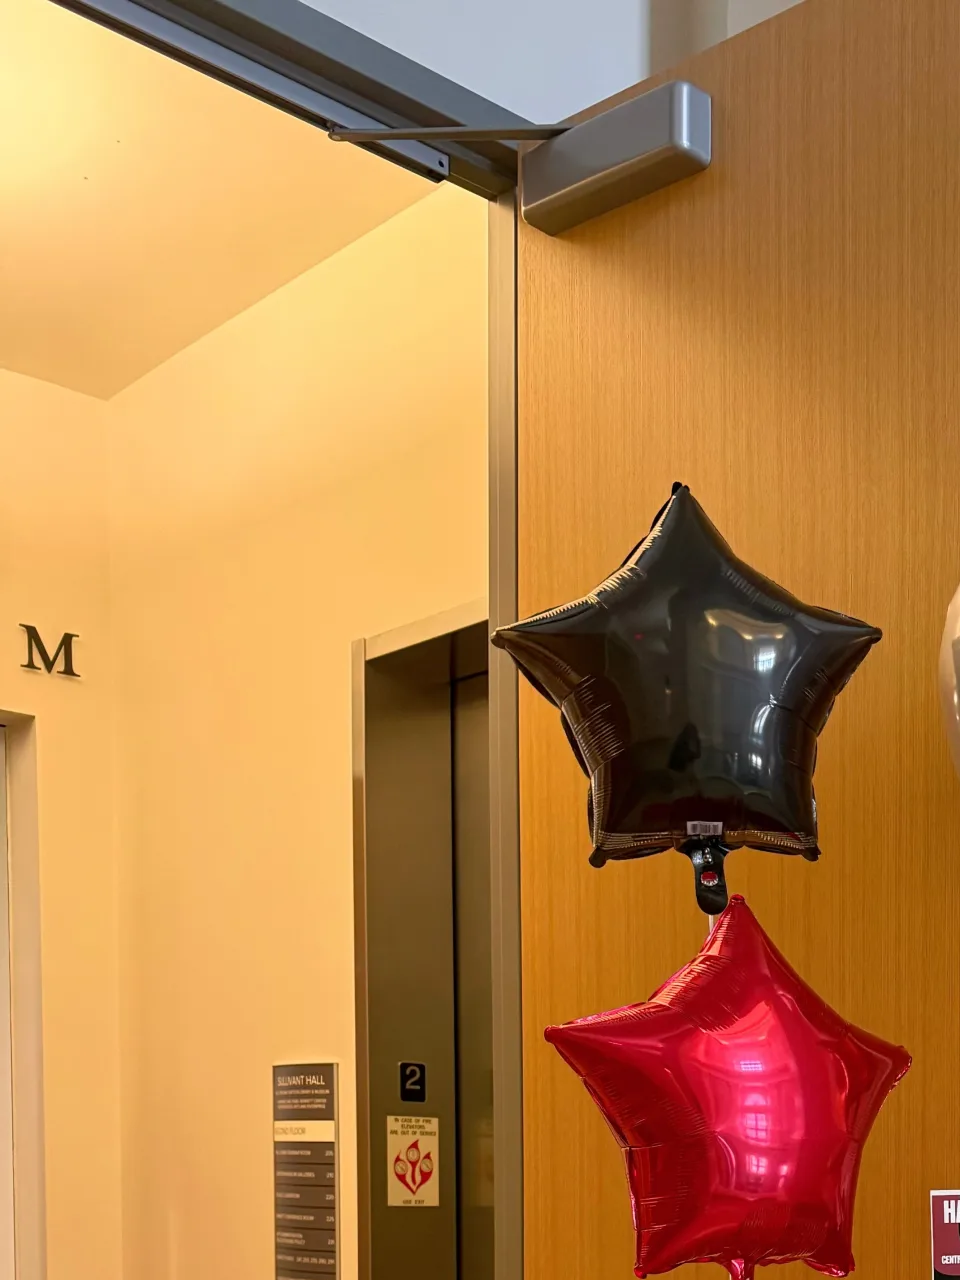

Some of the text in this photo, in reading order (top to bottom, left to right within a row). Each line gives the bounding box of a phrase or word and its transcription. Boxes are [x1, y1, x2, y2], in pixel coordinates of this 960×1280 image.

[19, 623, 81, 677] M
[305, 1074, 326, 1085] HALL
[406, 1065, 421, 1089] 2
